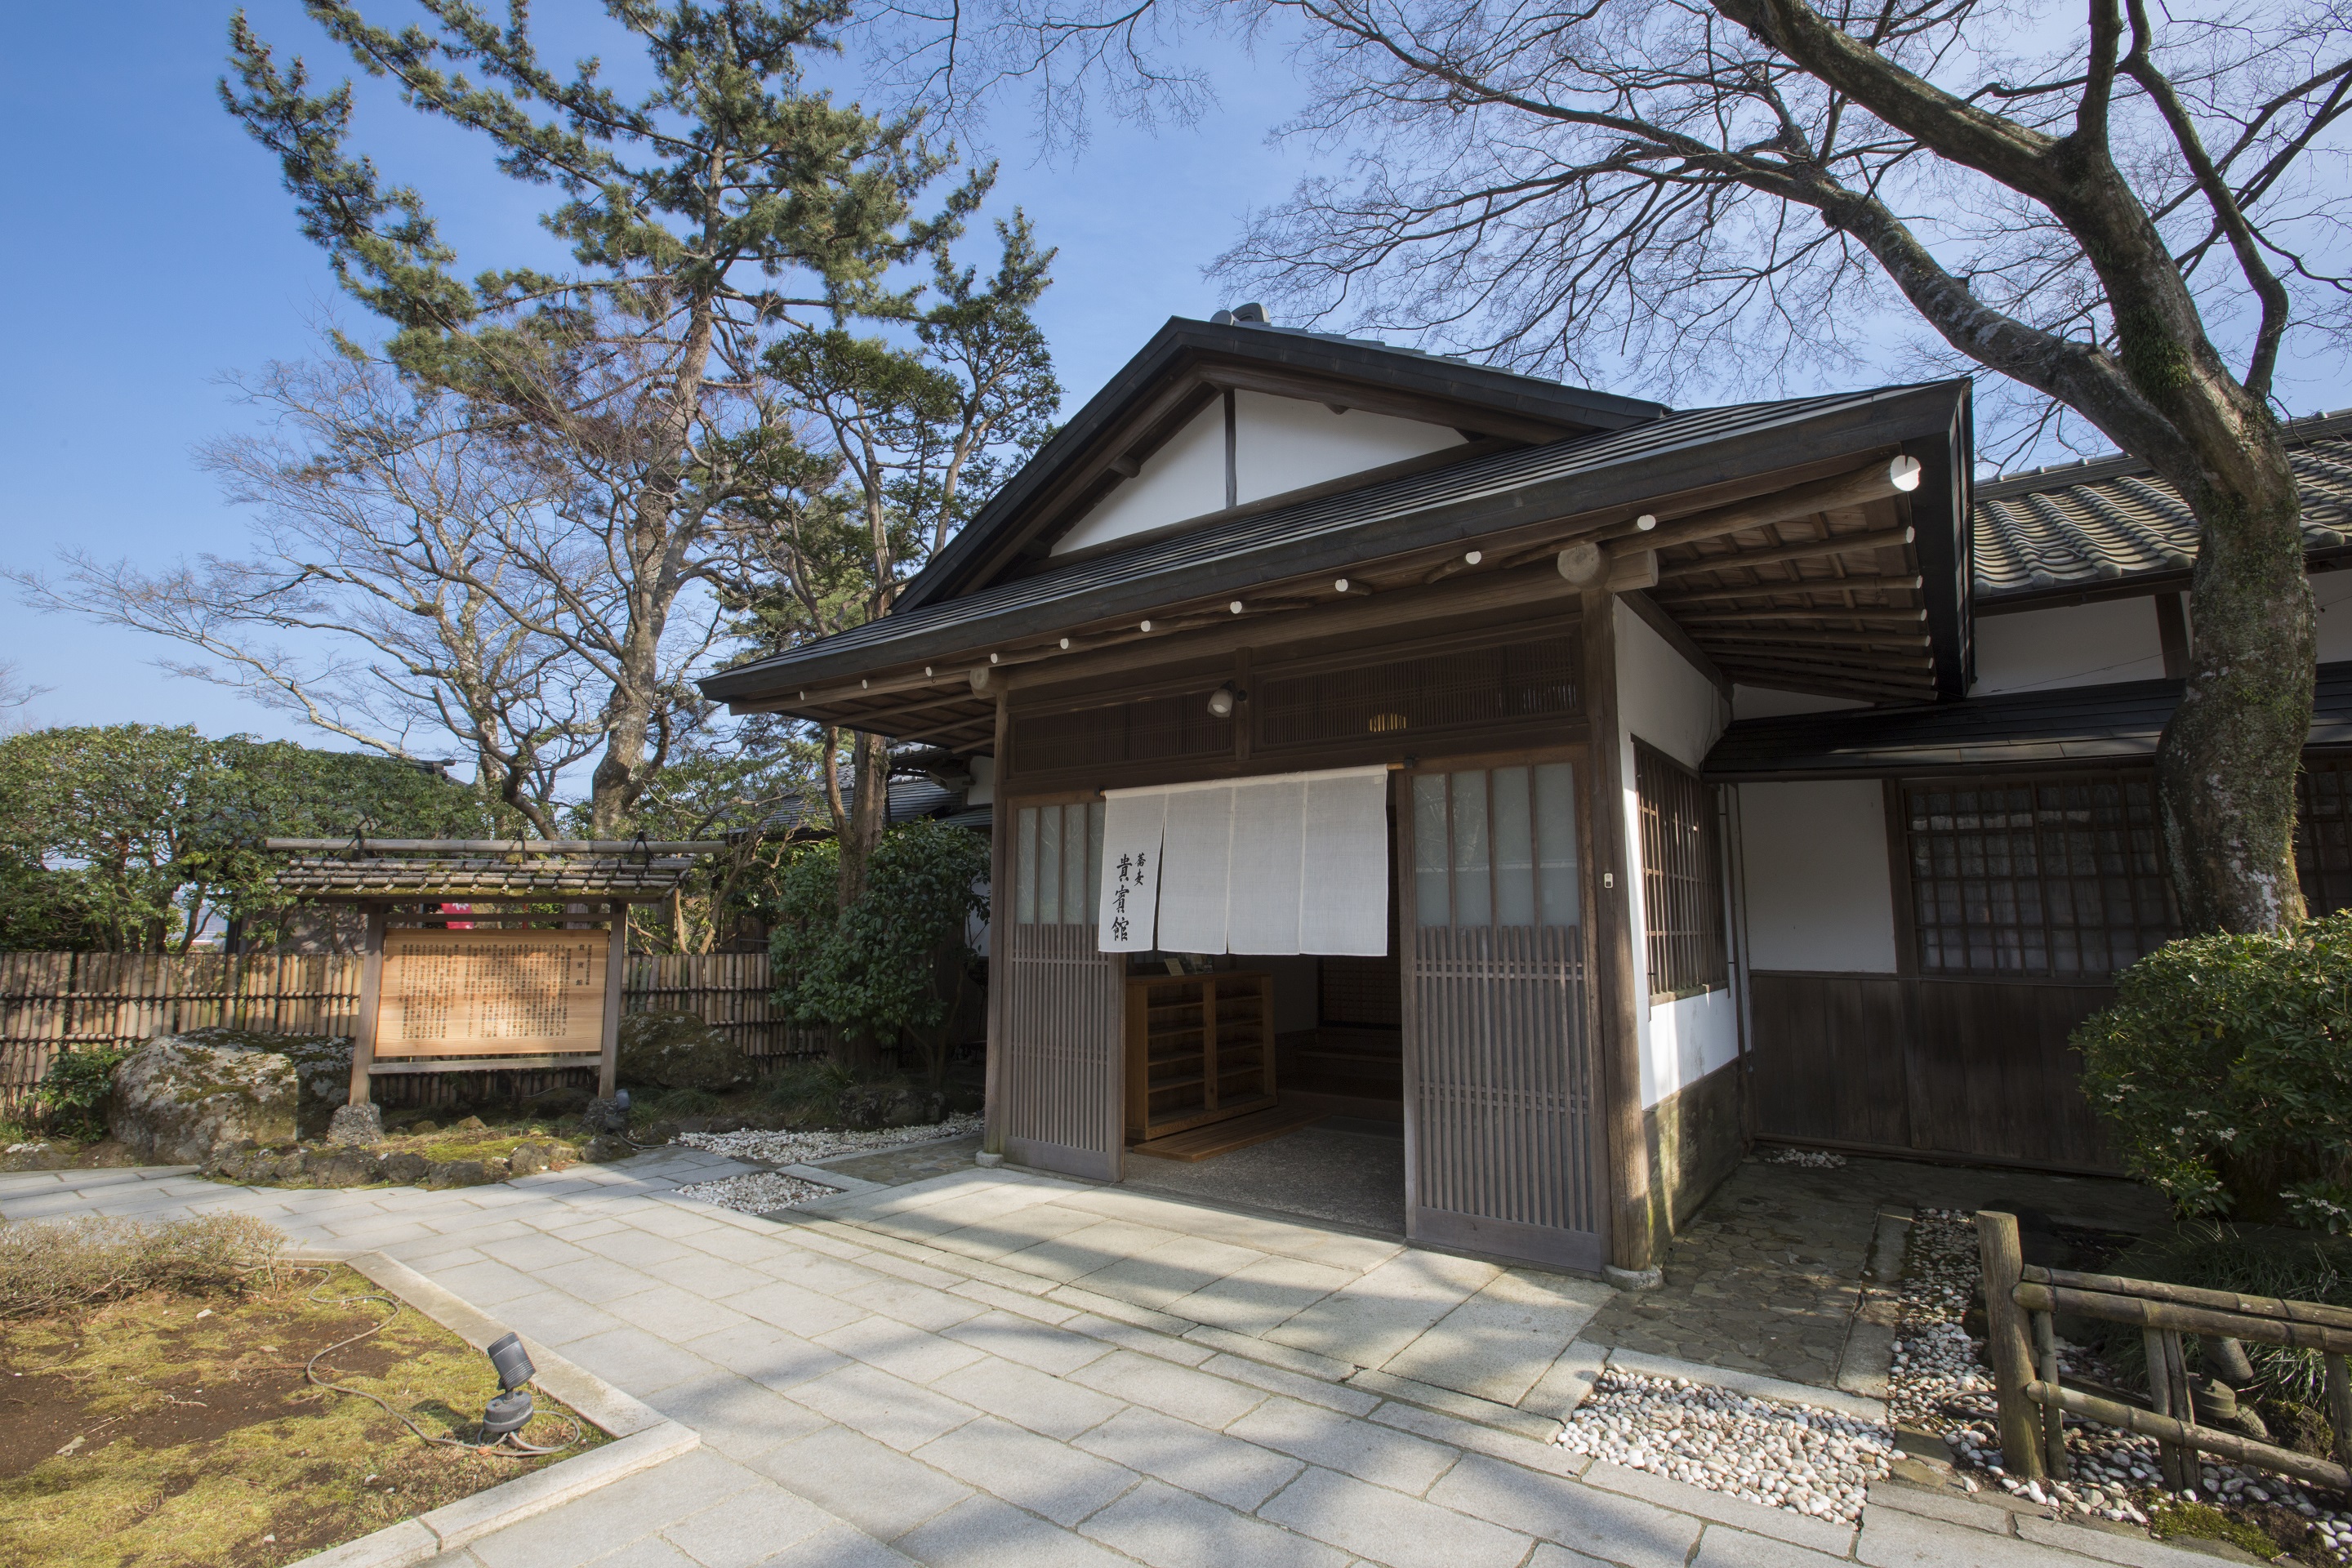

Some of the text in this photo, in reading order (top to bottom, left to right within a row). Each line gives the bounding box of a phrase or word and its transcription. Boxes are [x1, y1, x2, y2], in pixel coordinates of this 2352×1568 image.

[1134, 853, 1146, 886] 蕎麦
[1111, 853, 1133, 941] 貴賓館
[576, 943, 585, 986] 貴賓館
